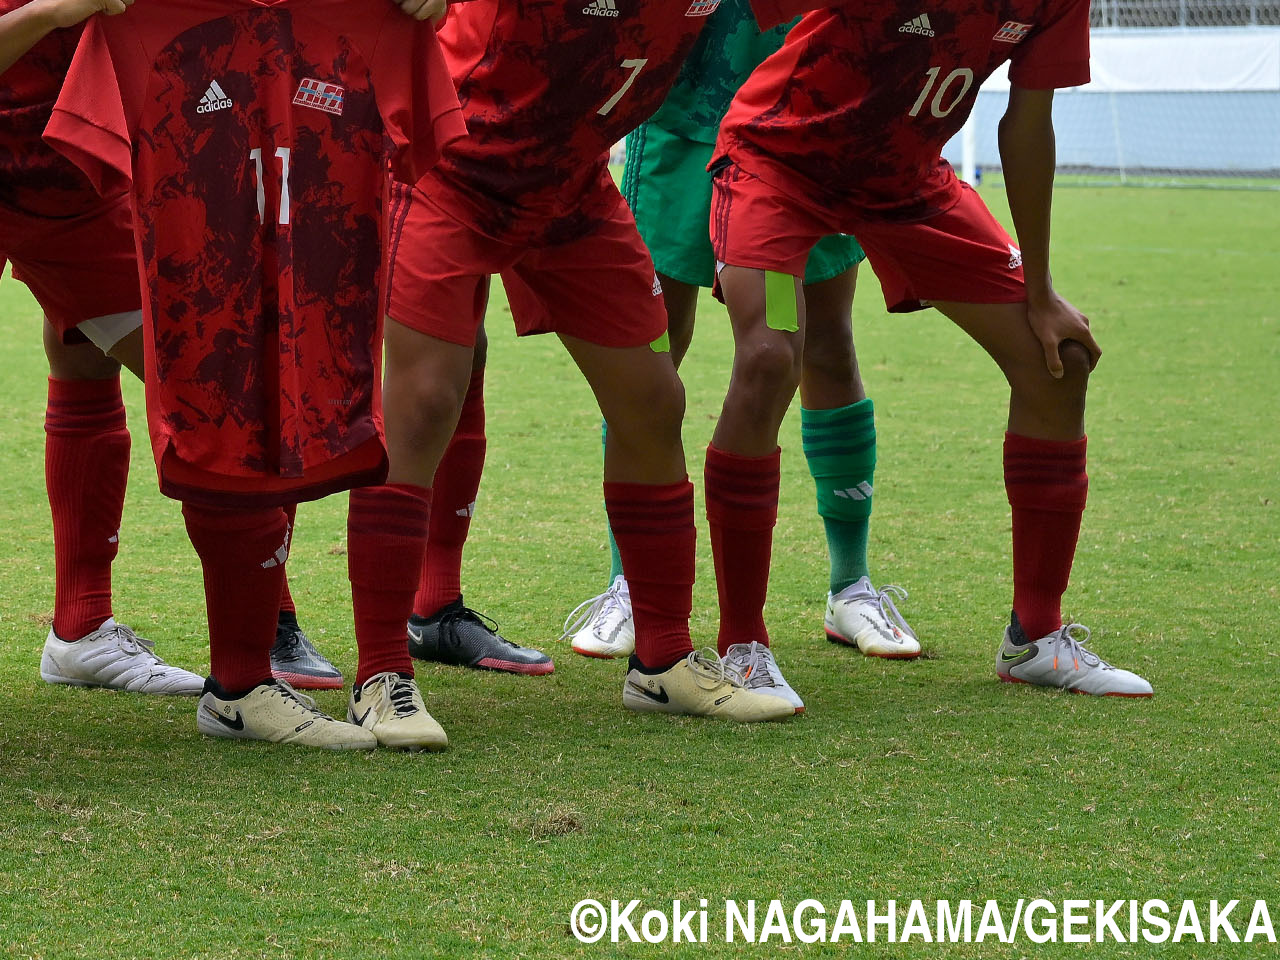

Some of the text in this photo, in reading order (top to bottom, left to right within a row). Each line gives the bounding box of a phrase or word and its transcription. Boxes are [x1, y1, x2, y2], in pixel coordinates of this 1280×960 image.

[582, 5, 620, 18] adidas
[898, 24, 936, 38] adidas
[596, 58, 649, 116] 7
[908, 66, 974, 119] 10
[196, 97, 233, 114] adidas
[249, 147, 291, 225] 11
